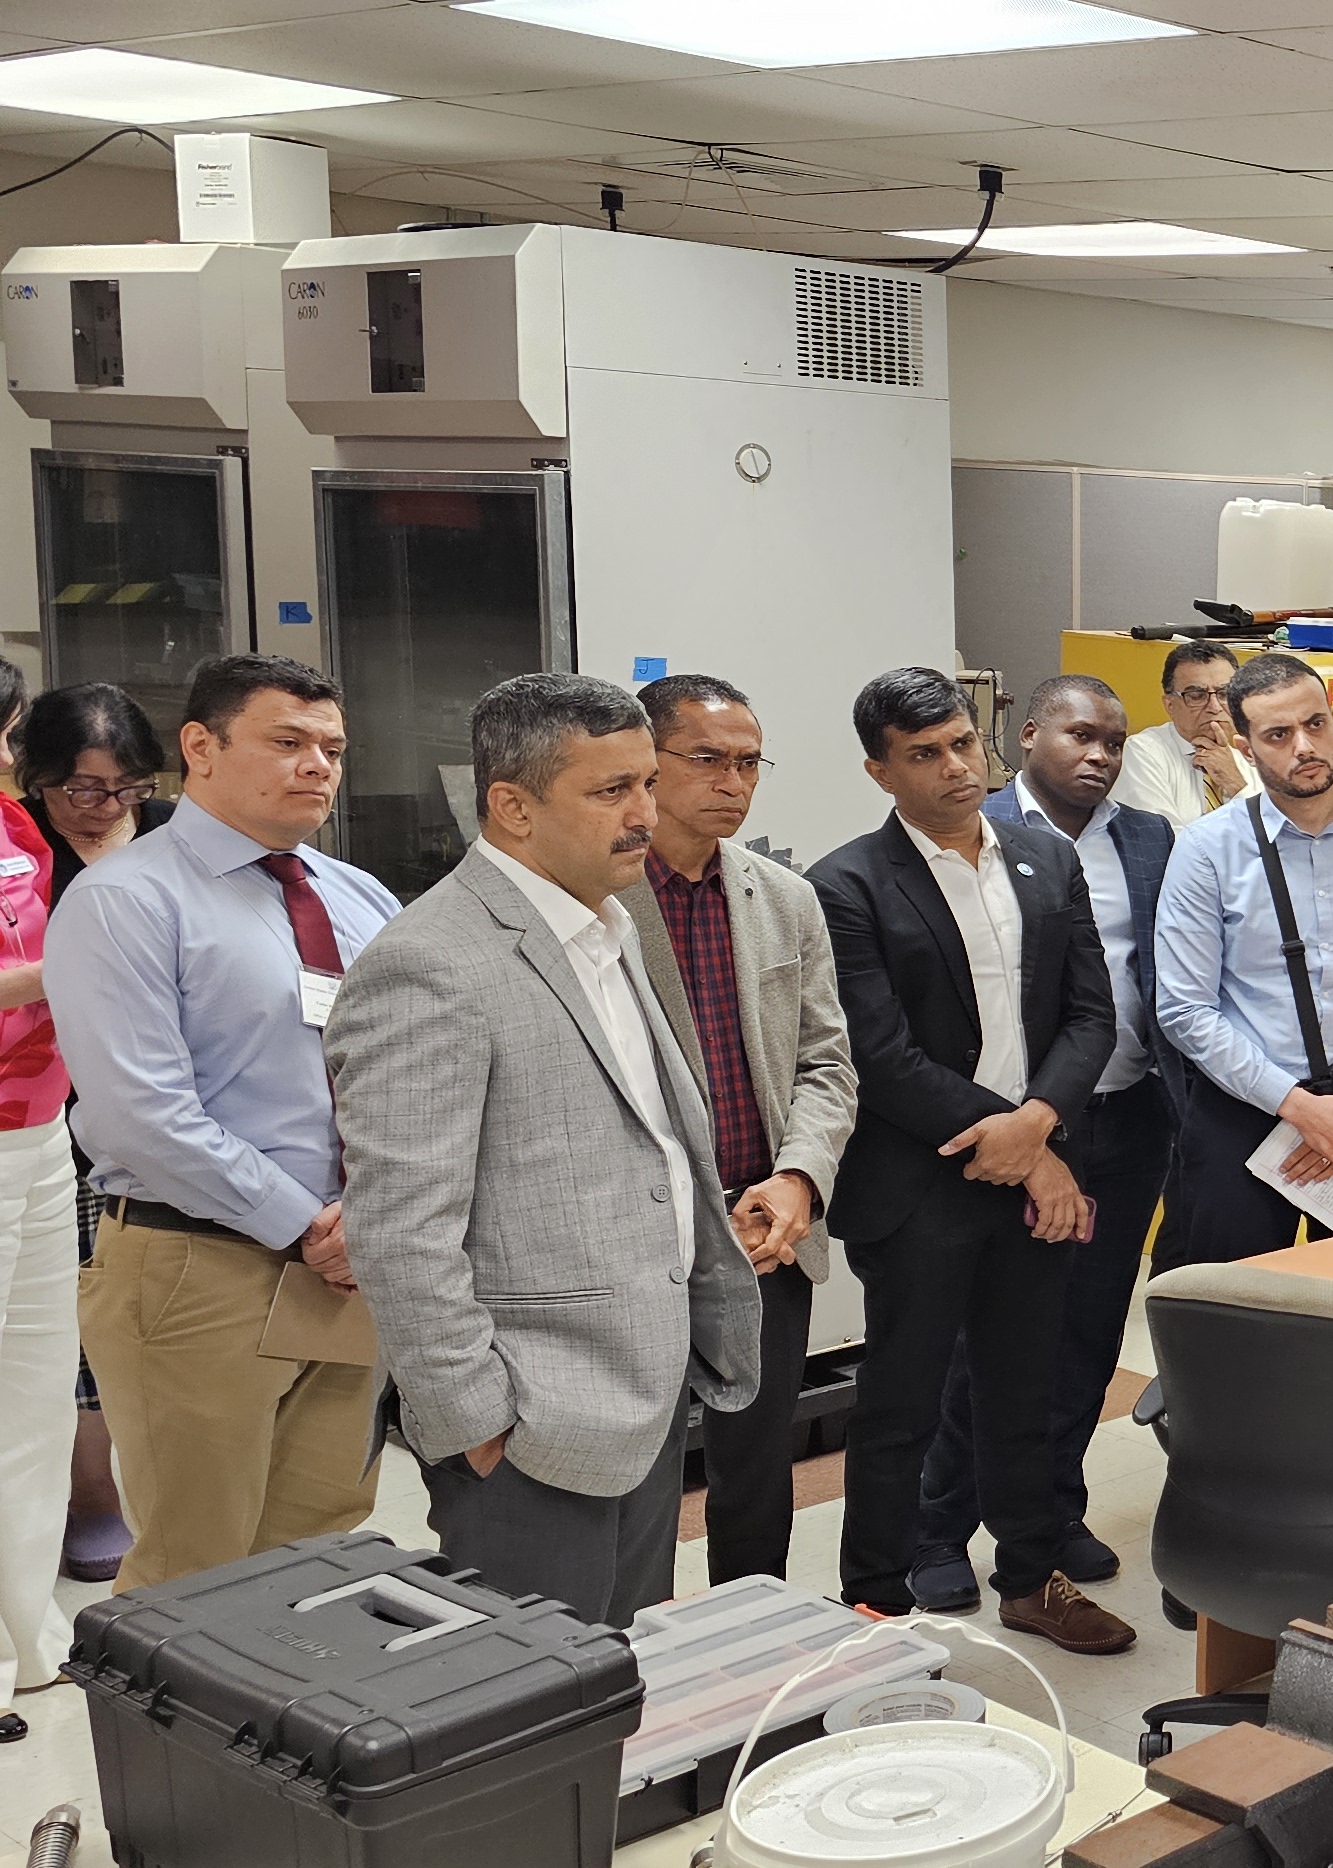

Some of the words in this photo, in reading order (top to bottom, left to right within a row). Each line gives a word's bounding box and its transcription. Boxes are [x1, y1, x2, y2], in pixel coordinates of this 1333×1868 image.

[6, 285, 38, 300] CARON
[287, 281, 326, 300] CARON
[297, 305, 319, 320] 6030
[285, 605, 300, 620] K
[639, 658, 656, 675] J
